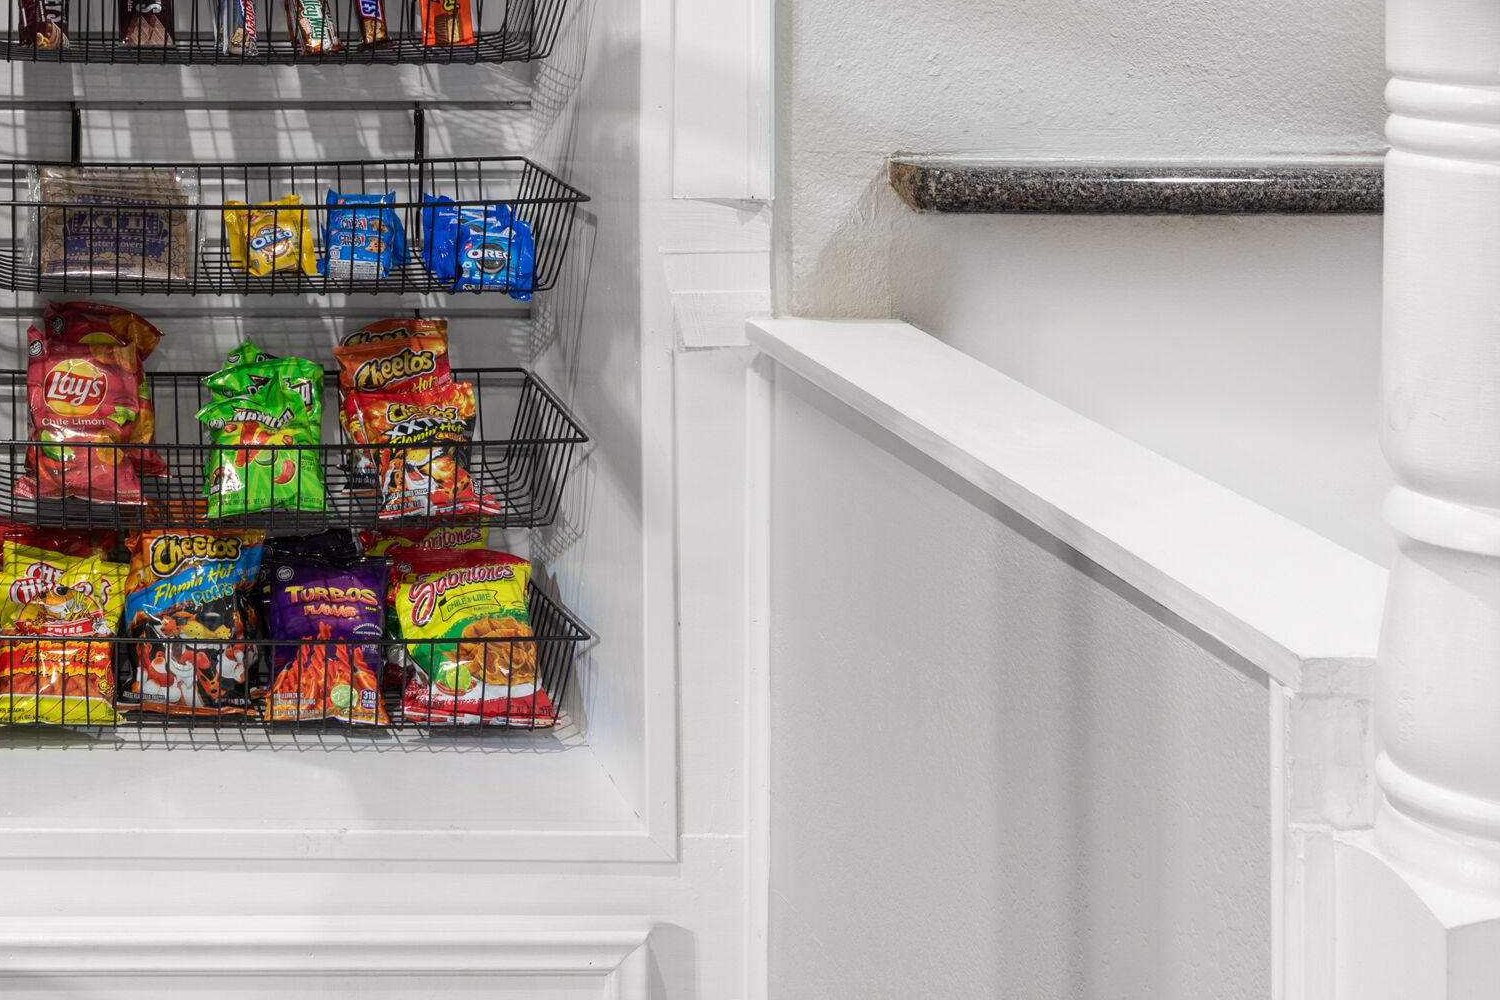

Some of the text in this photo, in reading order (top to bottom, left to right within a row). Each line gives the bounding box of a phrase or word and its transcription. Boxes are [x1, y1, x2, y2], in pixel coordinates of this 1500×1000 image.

[82, 215, 118, 229] ACT
[85, 239, 114, 247] Butter
[251, 231, 293, 250] OREO
[353, 347, 436, 392] Cheetos
[47, 371, 104, 406] Lay's
[413, 375, 436, 393] Hot
[41, 417, 106, 427] Chile Limón
[229, 407, 295, 430] NAMITA
[439, 422, 465, 434] Hot
[418, 527, 482, 550] ritones
[150, 534, 242, 577] Cheetos
[154, 563, 236, 607] Flamin' Hot
[191, 582, 235, 607] Puffs
[285, 585, 378, 606] TURBOS
[408, 564, 515, 627] Sabritones
[446, 593, 492, 613] CHILE LIME
[303, 603, 357, 618] FLAMAS
[47, 625, 83, 634] FRIES
[363, 690, 376, 700] 310
